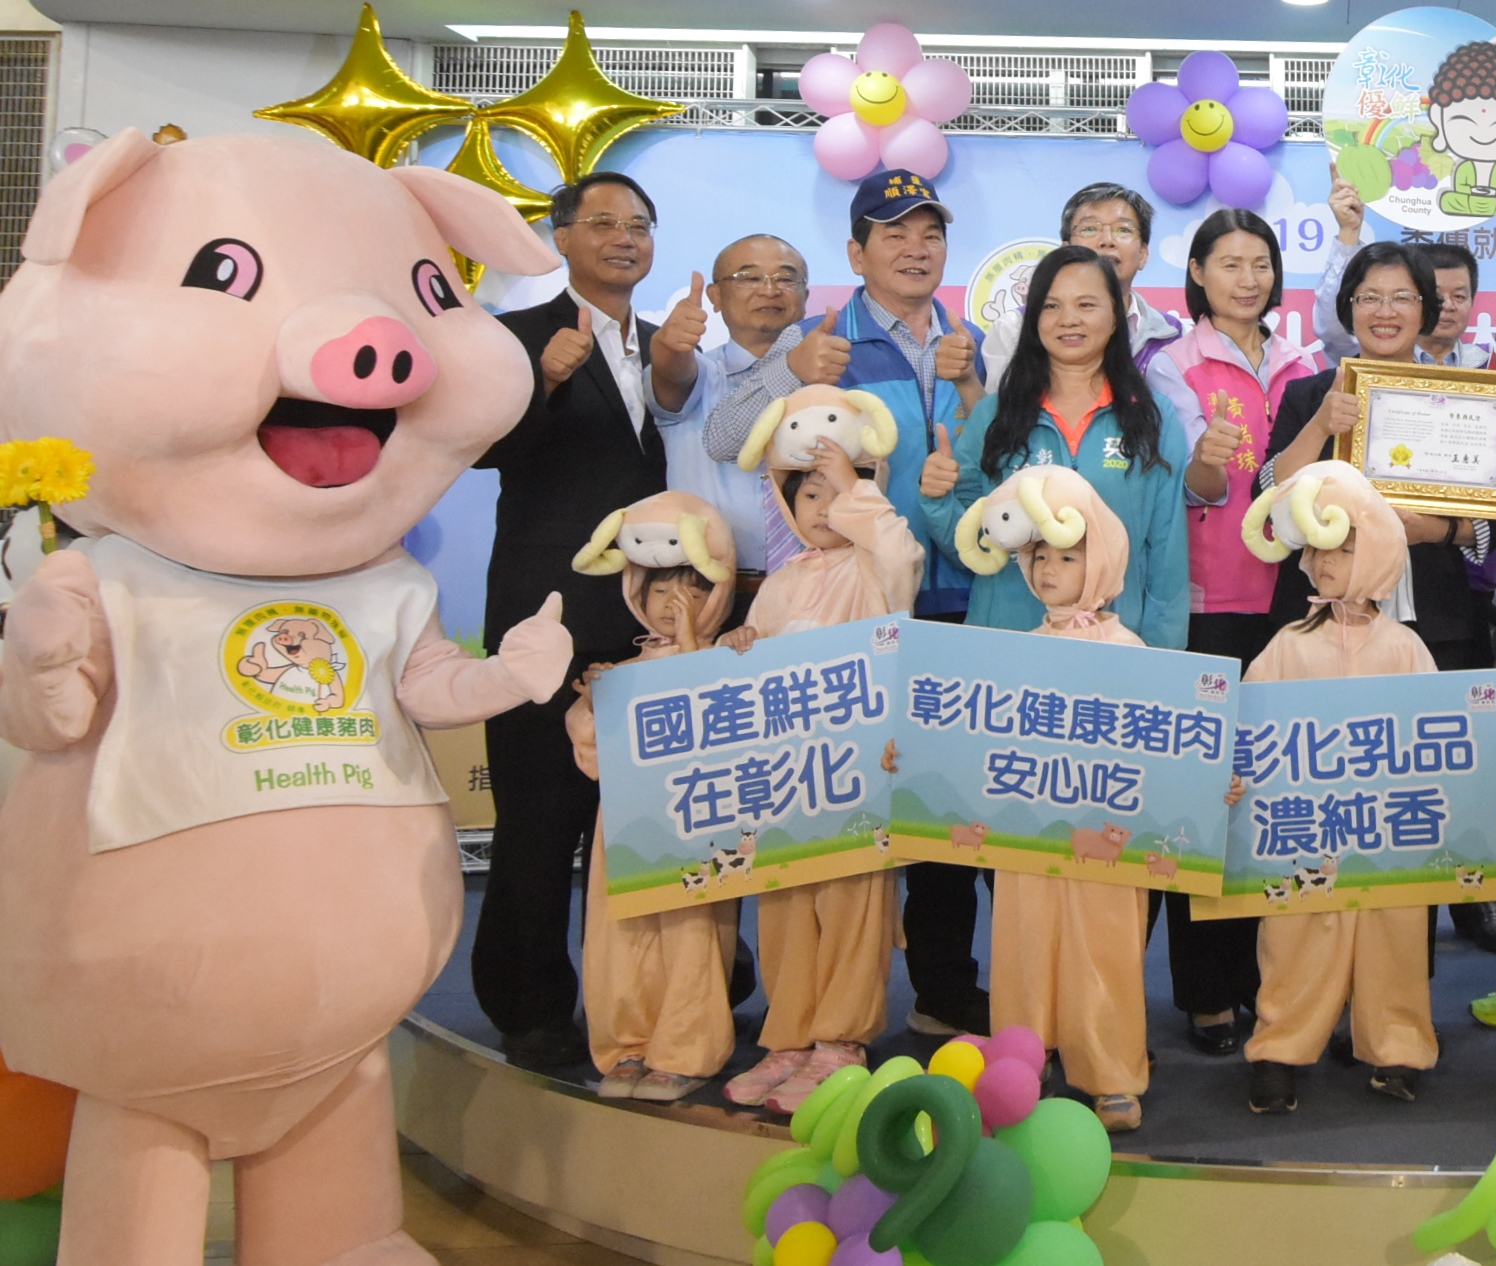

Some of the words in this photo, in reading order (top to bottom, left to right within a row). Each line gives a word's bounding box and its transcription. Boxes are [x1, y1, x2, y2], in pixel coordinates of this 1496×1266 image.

[1353, 47, 1420, 91] 彰化
[1358, 90, 1422, 122] 優鮮
[1401, 205, 1431, 216] County
[1103, 459, 1128, 469] 2020
[236, 716, 376, 745] 彰化健康豬肉
[635, 659, 885, 760] 國產鮮乳
[911, 677, 1223, 760] 彰化健康豬肉
[254, 762, 336, 792] Health
[342, 763, 374, 789] Pig
[672, 743, 861, 833] 在彰化
[986, 751, 1143, 812] 安心吃
[1254, 788, 1446, 856] 濃純香
